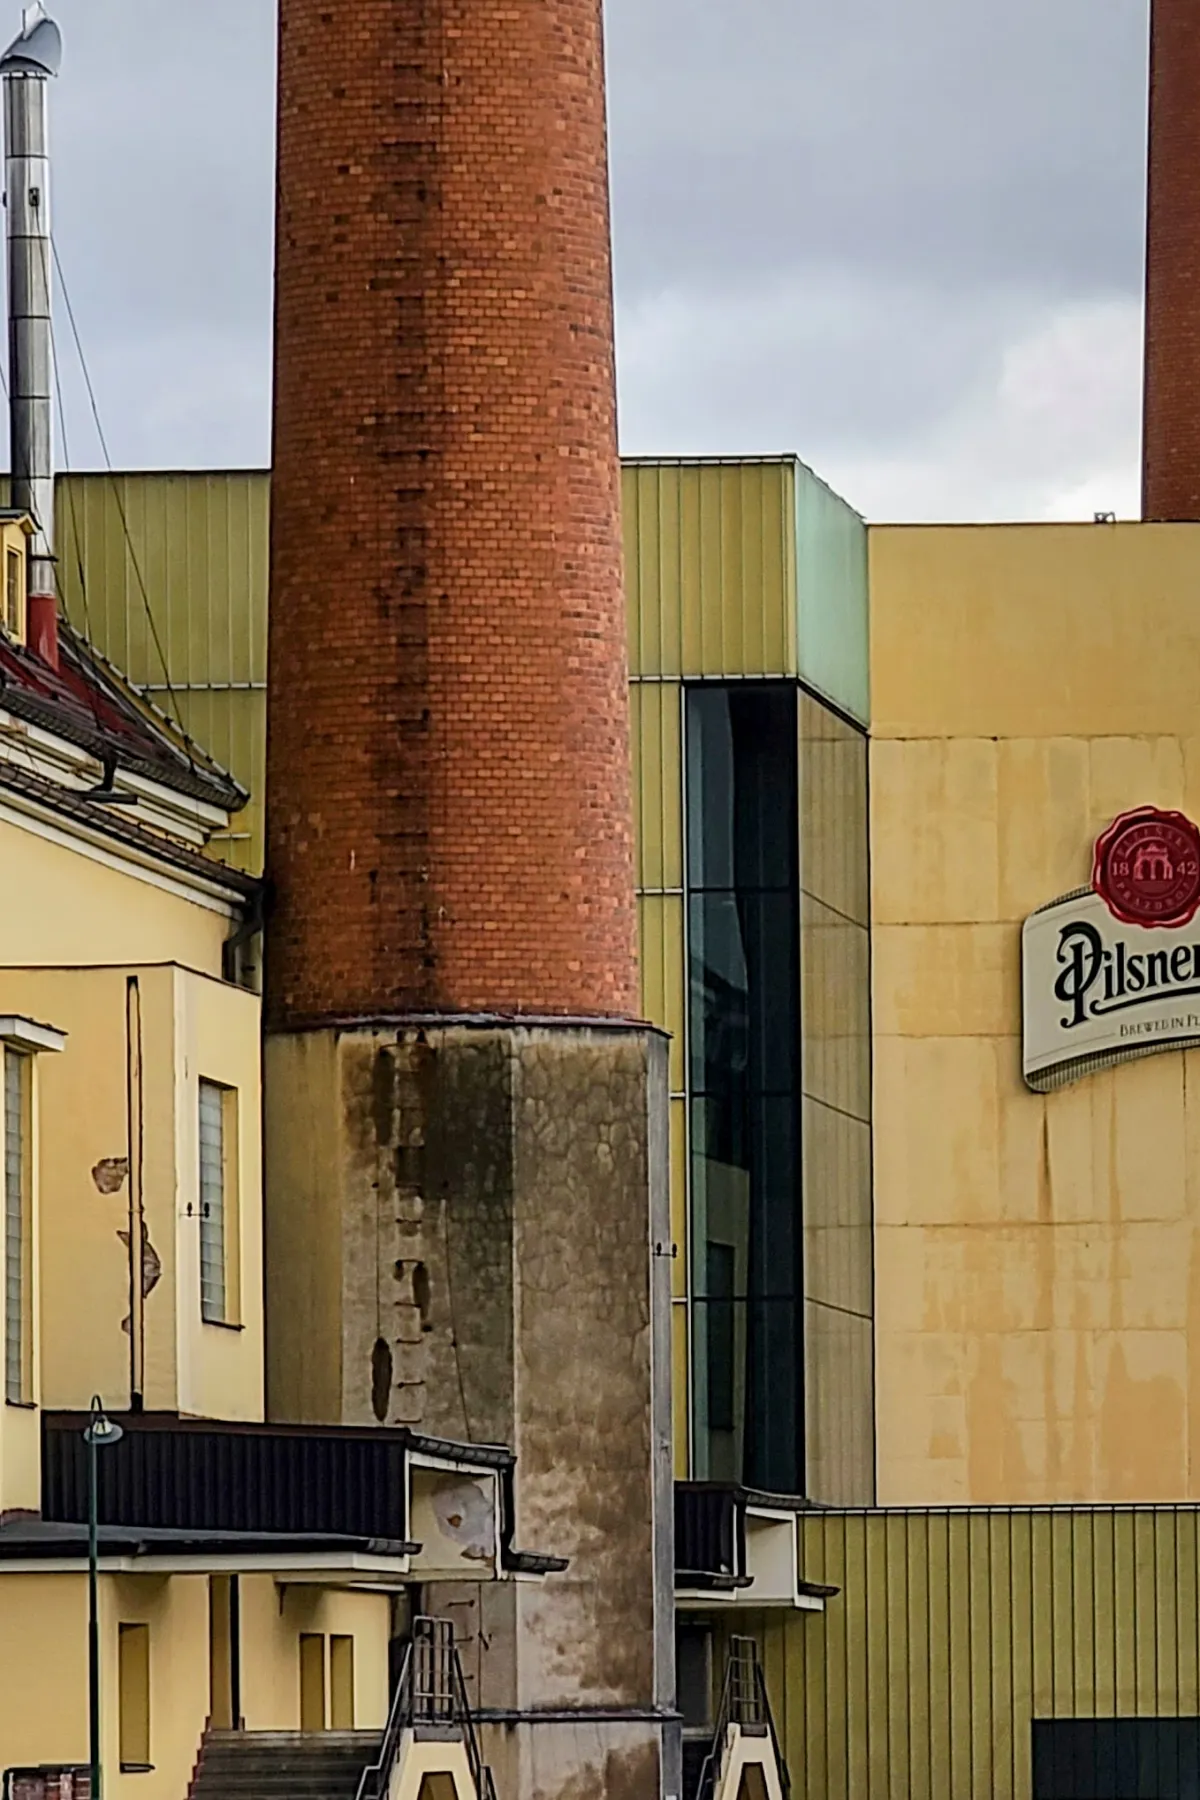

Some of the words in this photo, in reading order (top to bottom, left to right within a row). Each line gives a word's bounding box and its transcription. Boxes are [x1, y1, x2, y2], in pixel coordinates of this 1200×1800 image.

[1112, 861, 1130, 877] 18
[1176, 861, 1198, 877] 42
[1120, 1019, 1169, 1038] BREWED
[1171, 1016, 1184, 1029] IN
